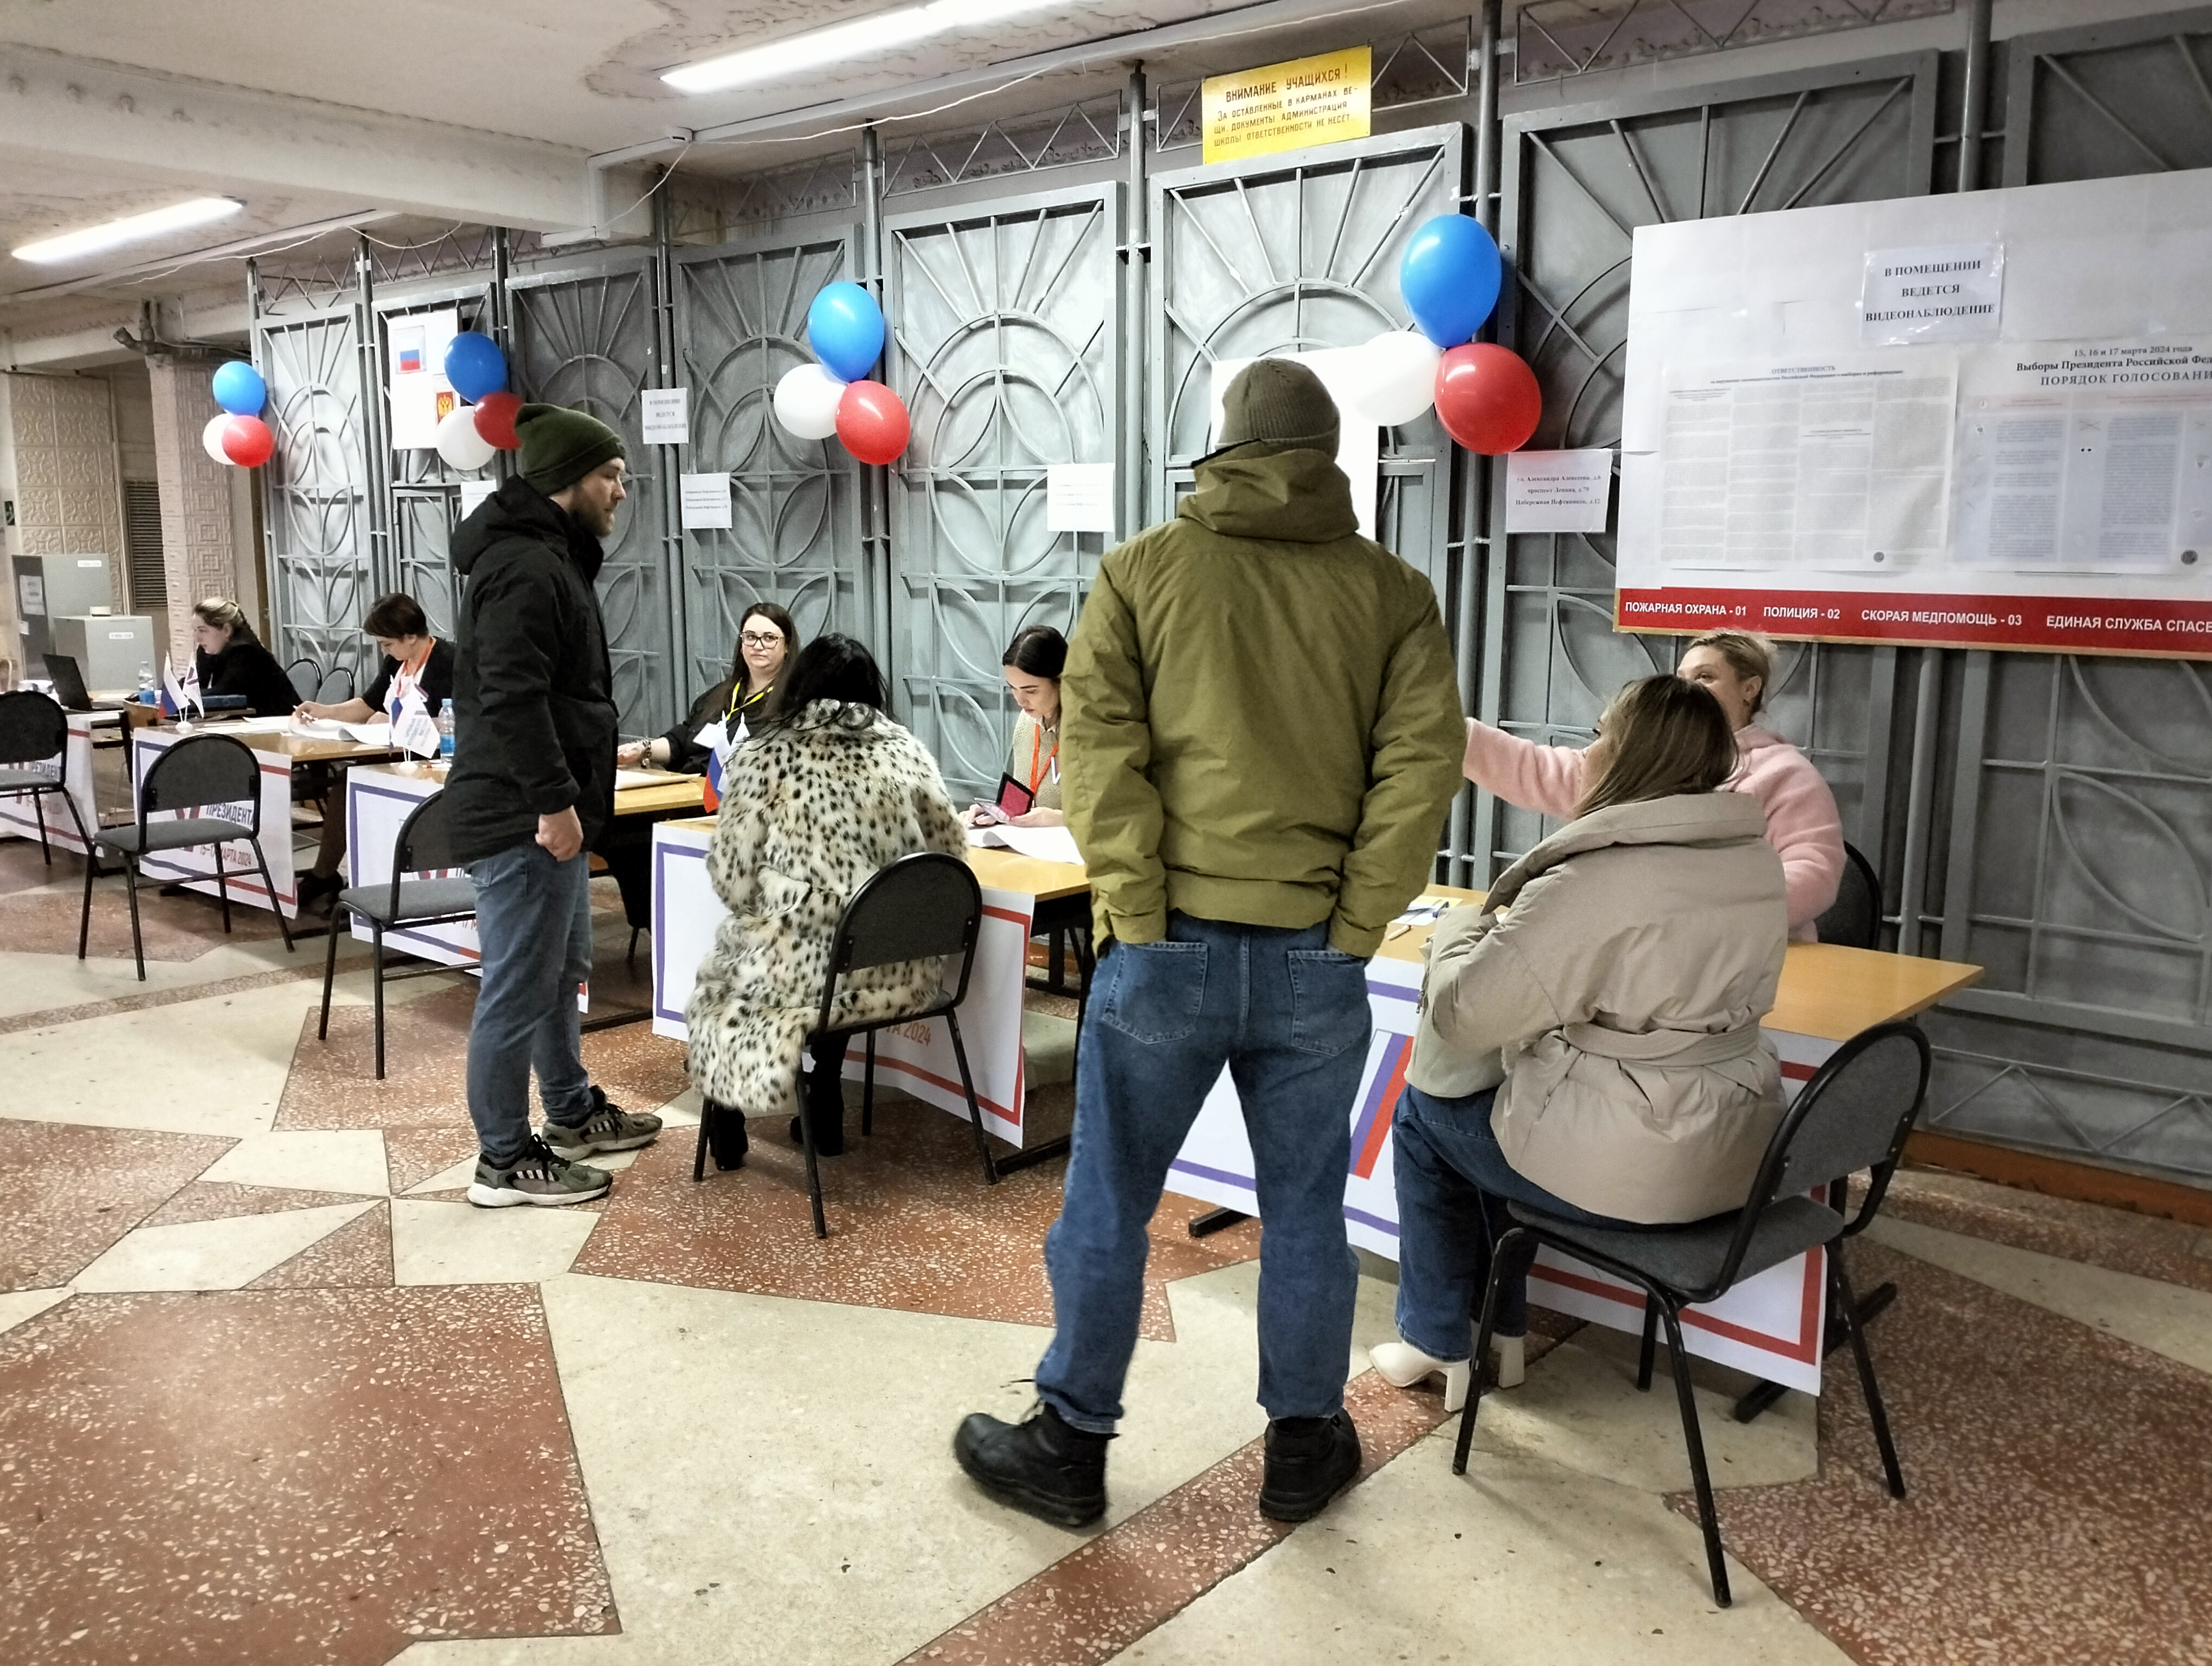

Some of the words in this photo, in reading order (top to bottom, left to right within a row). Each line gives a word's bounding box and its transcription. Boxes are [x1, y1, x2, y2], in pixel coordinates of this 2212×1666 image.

[1226, 82, 1276, 102] ВНИМАНИЕ
[1287, 68, 1340, 90] УЧАЩИХСЯ
[1232, 100, 1283, 118] ОСТАВЛЕННЫЕ
[1296, 89, 1337, 105] КАРМАНАХ
[1231, 115, 1275, 132] ДОКУМЕНТЫ
[1281, 101, 1347, 121] АДМИНИСТРАЦИЯ
[1214, 134, 1242, 146] ШКОЛЫ
[1247, 121, 1312, 140] ОТВЕТСТВЕННОСТИ
[1317, 118, 1324, 127] НЕ
[1885, 268, 1892, 277] В
[1895, 260, 1980, 276] ПОМЕЩЕНИИ
[1901, 284, 1960, 298] ВЕДЕТСЯ
[1866, 304, 1995, 322] ВИДЕОНАБЛЮДЕНИЕ
[2121, 348, 2147, 356] марта
[2172, 345, 2192, 353] года
[2016, 362, 2059, 373] Выборы
[2062, 360, 2123, 371] Президента
[2126, 356, 2188, 367] Российской
[2041, 374, 2108, 386] ПОРЯДОК
[1625, 602, 1682, 613] ПОЖАРНАЯ
[1685, 604, 1726, 615] ОХРАНА
[1735, 606, 1746, 616] 01
[1764, 606, 1818, 619] ПОЛИЦИЯ
[1828, 608, 1840, 619] 02
[1861, 610, 1909, 621] СКОРАЯ
[1912, 612, 1996, 626] МЕДПОМОЩЬ
[2008, 614, 2022, 625] 03
[2047, 616, 2101, 629] ЕДИНАЯ
[2105, 617, 2162, 631] СЛУЖБА
[2166, 620, 2212, 632] СПАСЕ
[903, 1022, 931, 1047] 2024
